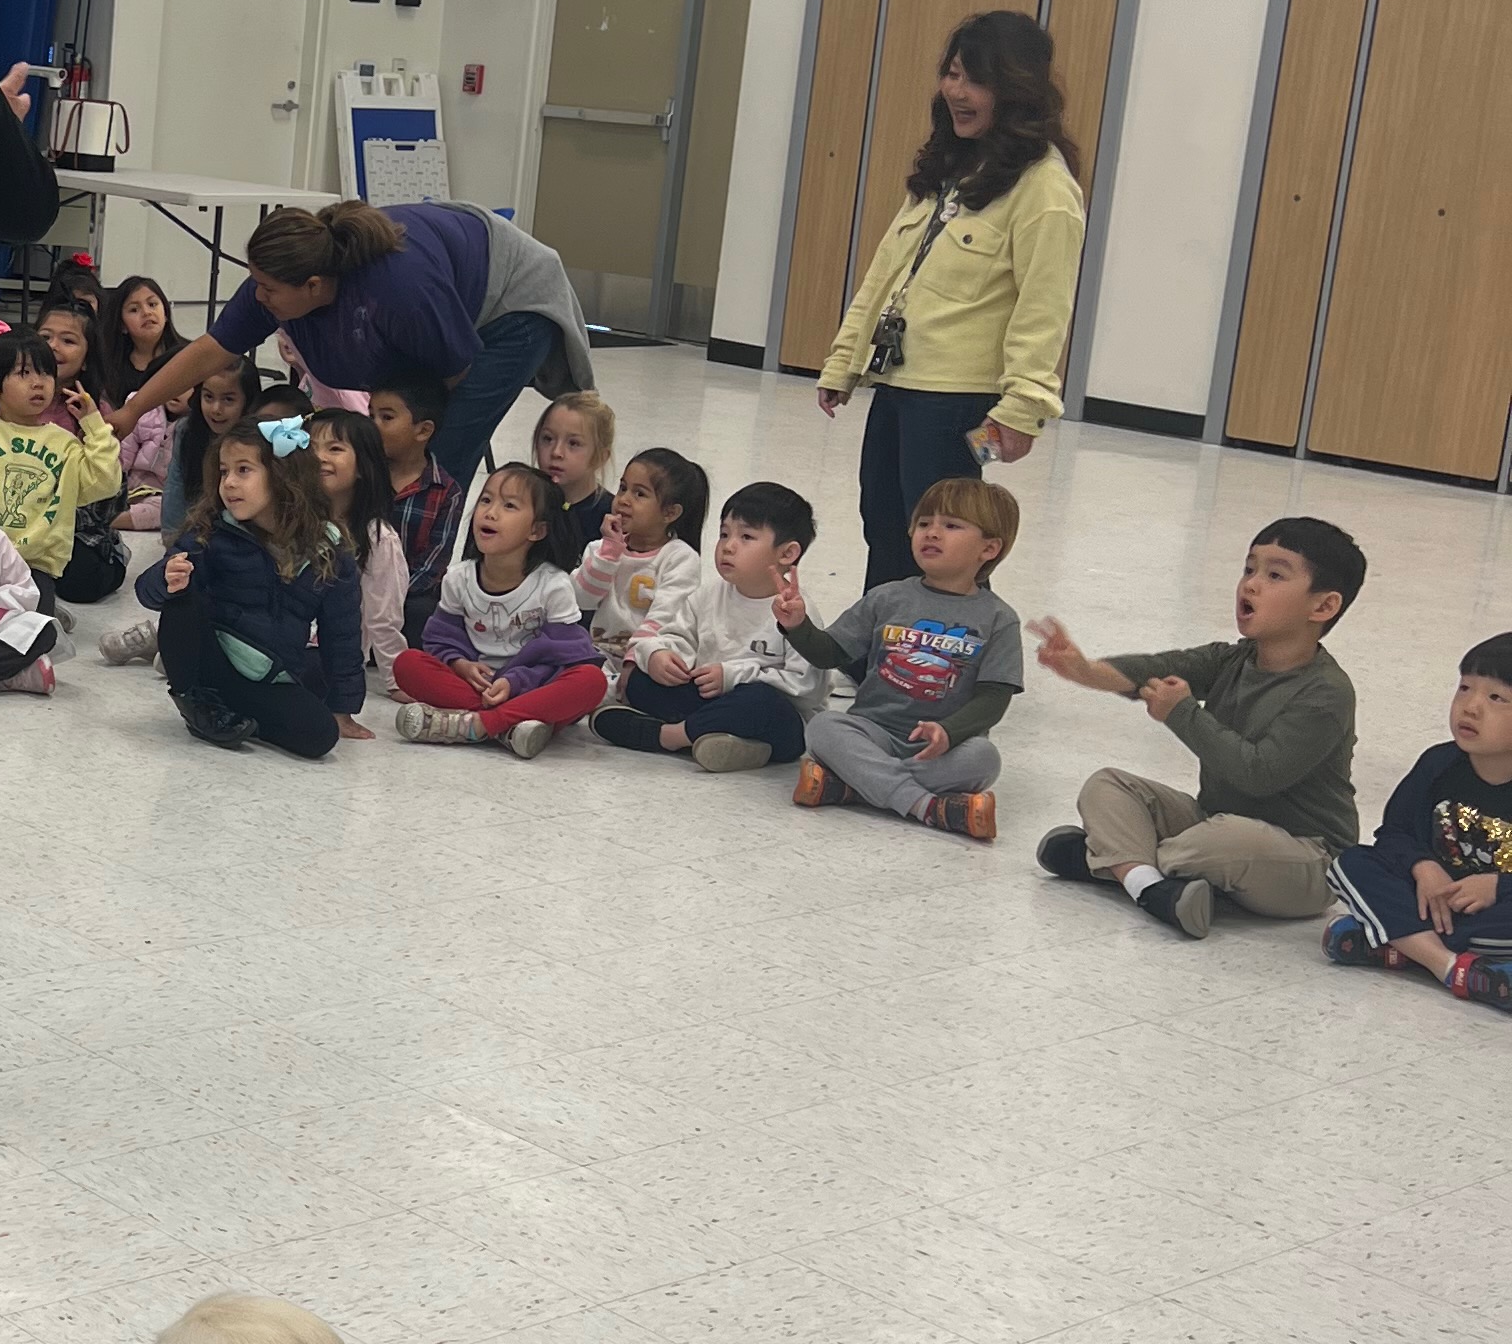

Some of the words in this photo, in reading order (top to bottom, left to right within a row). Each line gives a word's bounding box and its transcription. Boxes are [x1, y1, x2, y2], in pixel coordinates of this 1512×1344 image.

[630, 575, 656, 608] C
[887, 626, 919, 644] LAS
[920, 632, 977, 657] VEGAS
